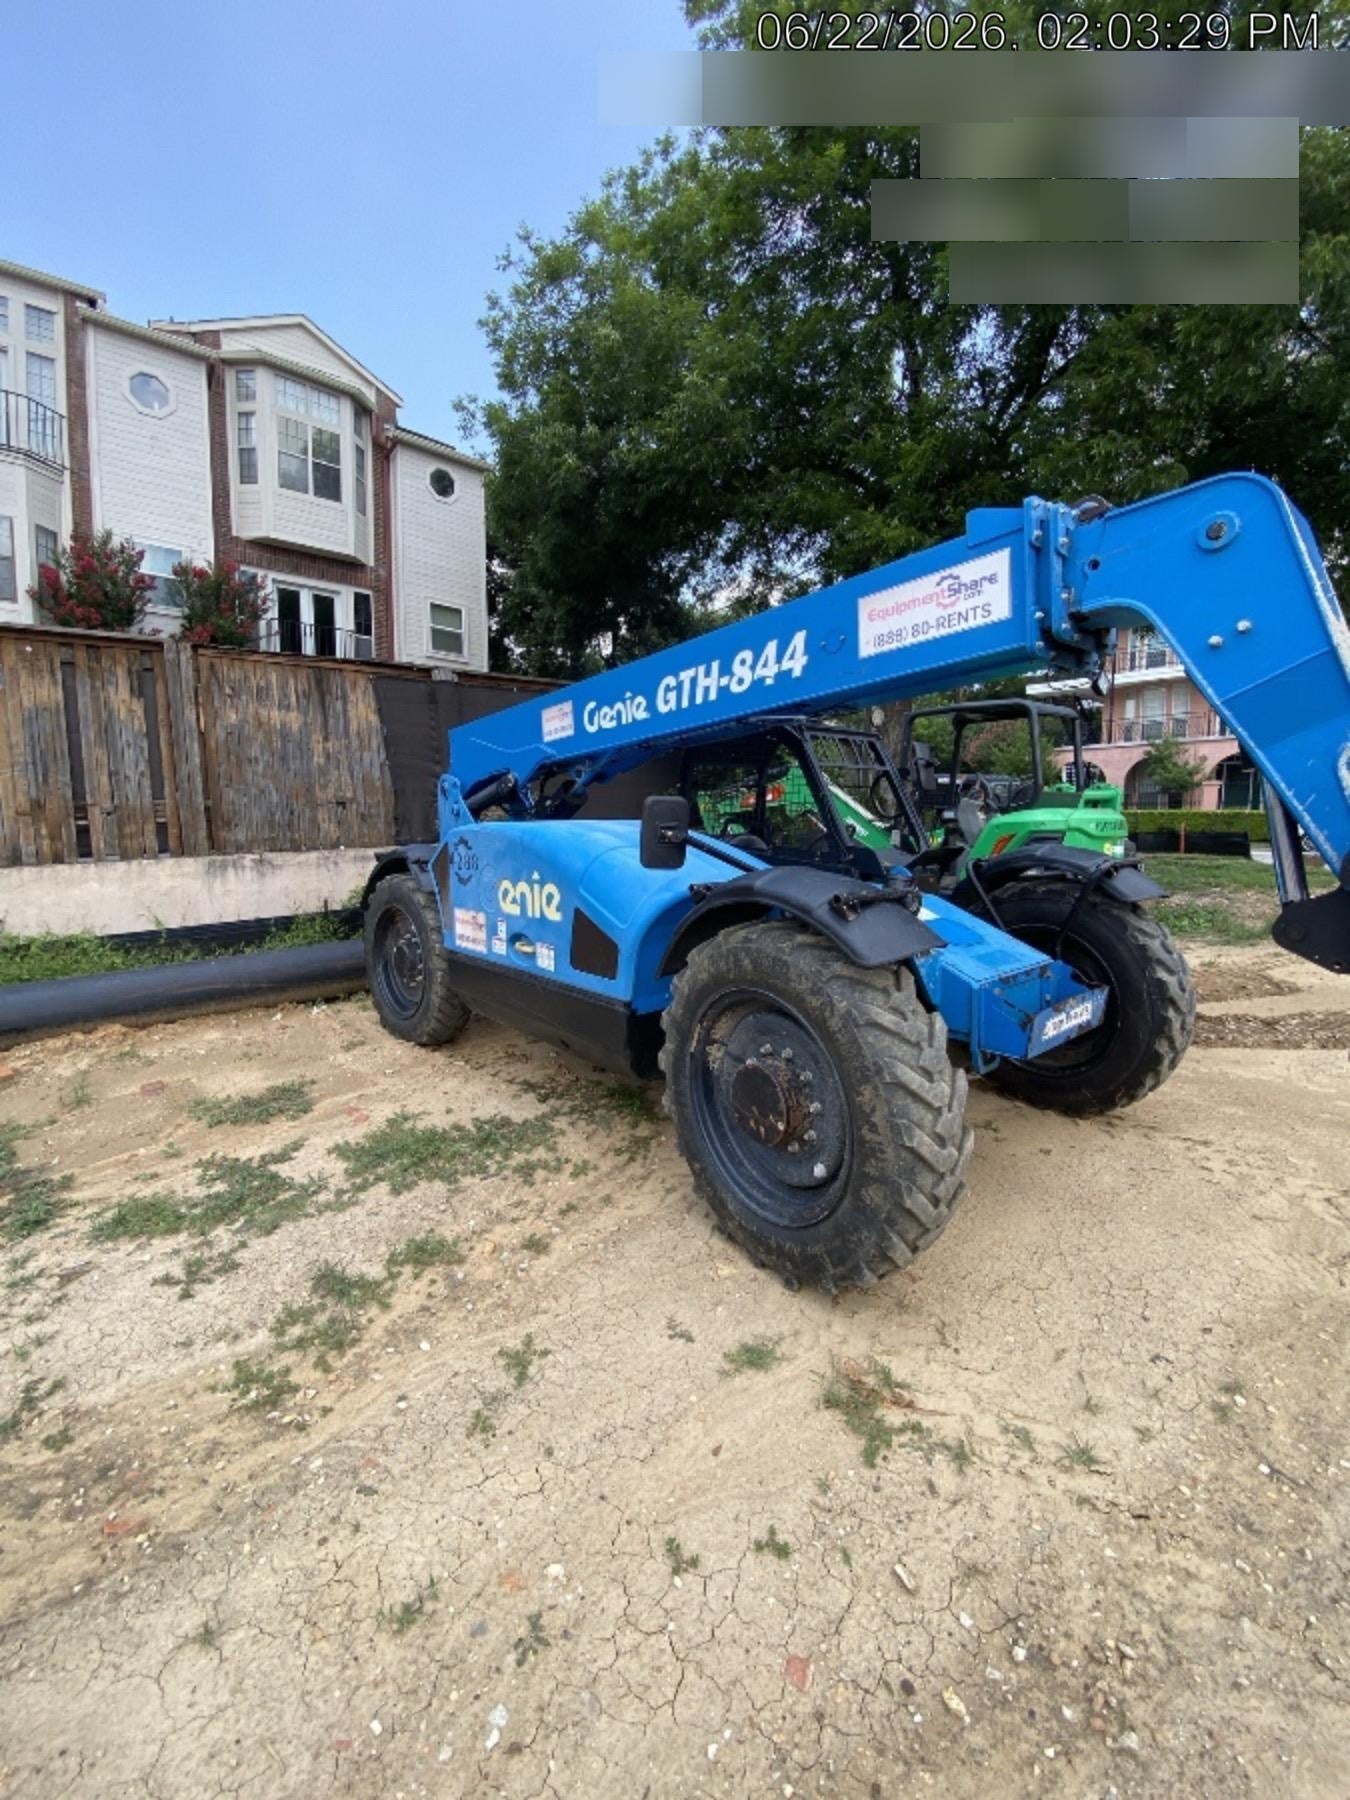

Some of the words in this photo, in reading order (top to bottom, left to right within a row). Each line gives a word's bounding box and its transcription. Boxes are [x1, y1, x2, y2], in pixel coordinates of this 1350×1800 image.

[873, 625, 909, 649] (888)
[911, 602, 992, 638] 80-RENTS
[583, 691, 650, 734] Genie
[656, 629, 808, 714] GTH-844
